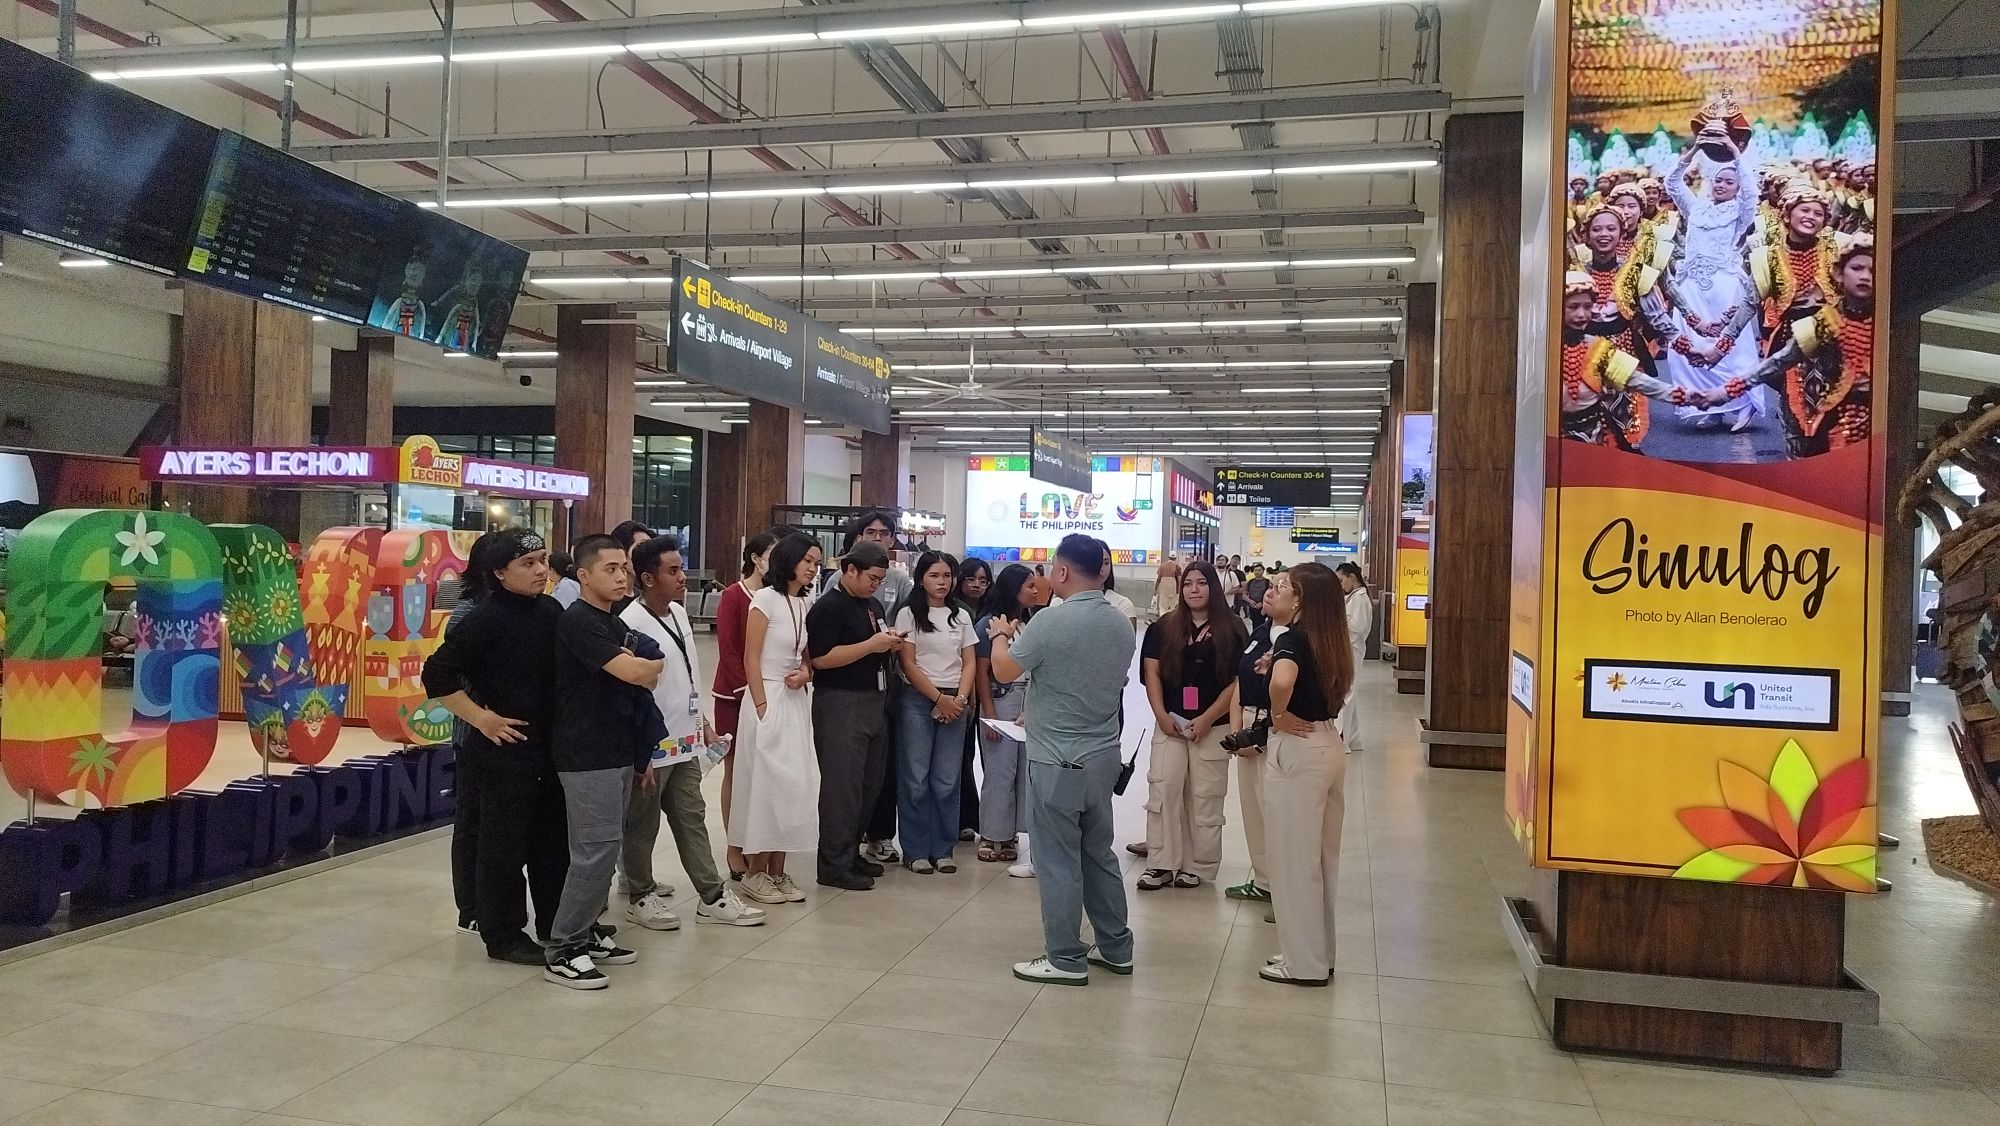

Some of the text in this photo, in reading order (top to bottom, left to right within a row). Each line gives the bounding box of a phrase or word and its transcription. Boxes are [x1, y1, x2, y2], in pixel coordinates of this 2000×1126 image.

[712, 290, 788, 334] Check-in Counters 1-29
[720, 329, 746, 350] Arrivals
[750, 340, 771, 360] Airport
[772, 349, 792, 370] Village
[818, 336, 875, 371] Check-in Counters 30-64
[817, 365, 836, 383] Arrivals
[159, 451, 370, 476] AYERS LECHON
[432, 455, 459, 471] AYERS
[411, 470, 459, 483] LECHON
[465, 463, 589, 496] AYERS LECHON
[1020, 492, 1104, 519] LOVE
[1020, 521, 1038, 529] THE
[1042, 521, 1104, 531] PHILIPPINES
[1582, 517, 1840, 619] Sinulog
[1625, 609, 1787, 626] Photo by Allan Benolerao
[1760, 684, 1792, 693] United
[1760, 693, 1793, 702] Transit
